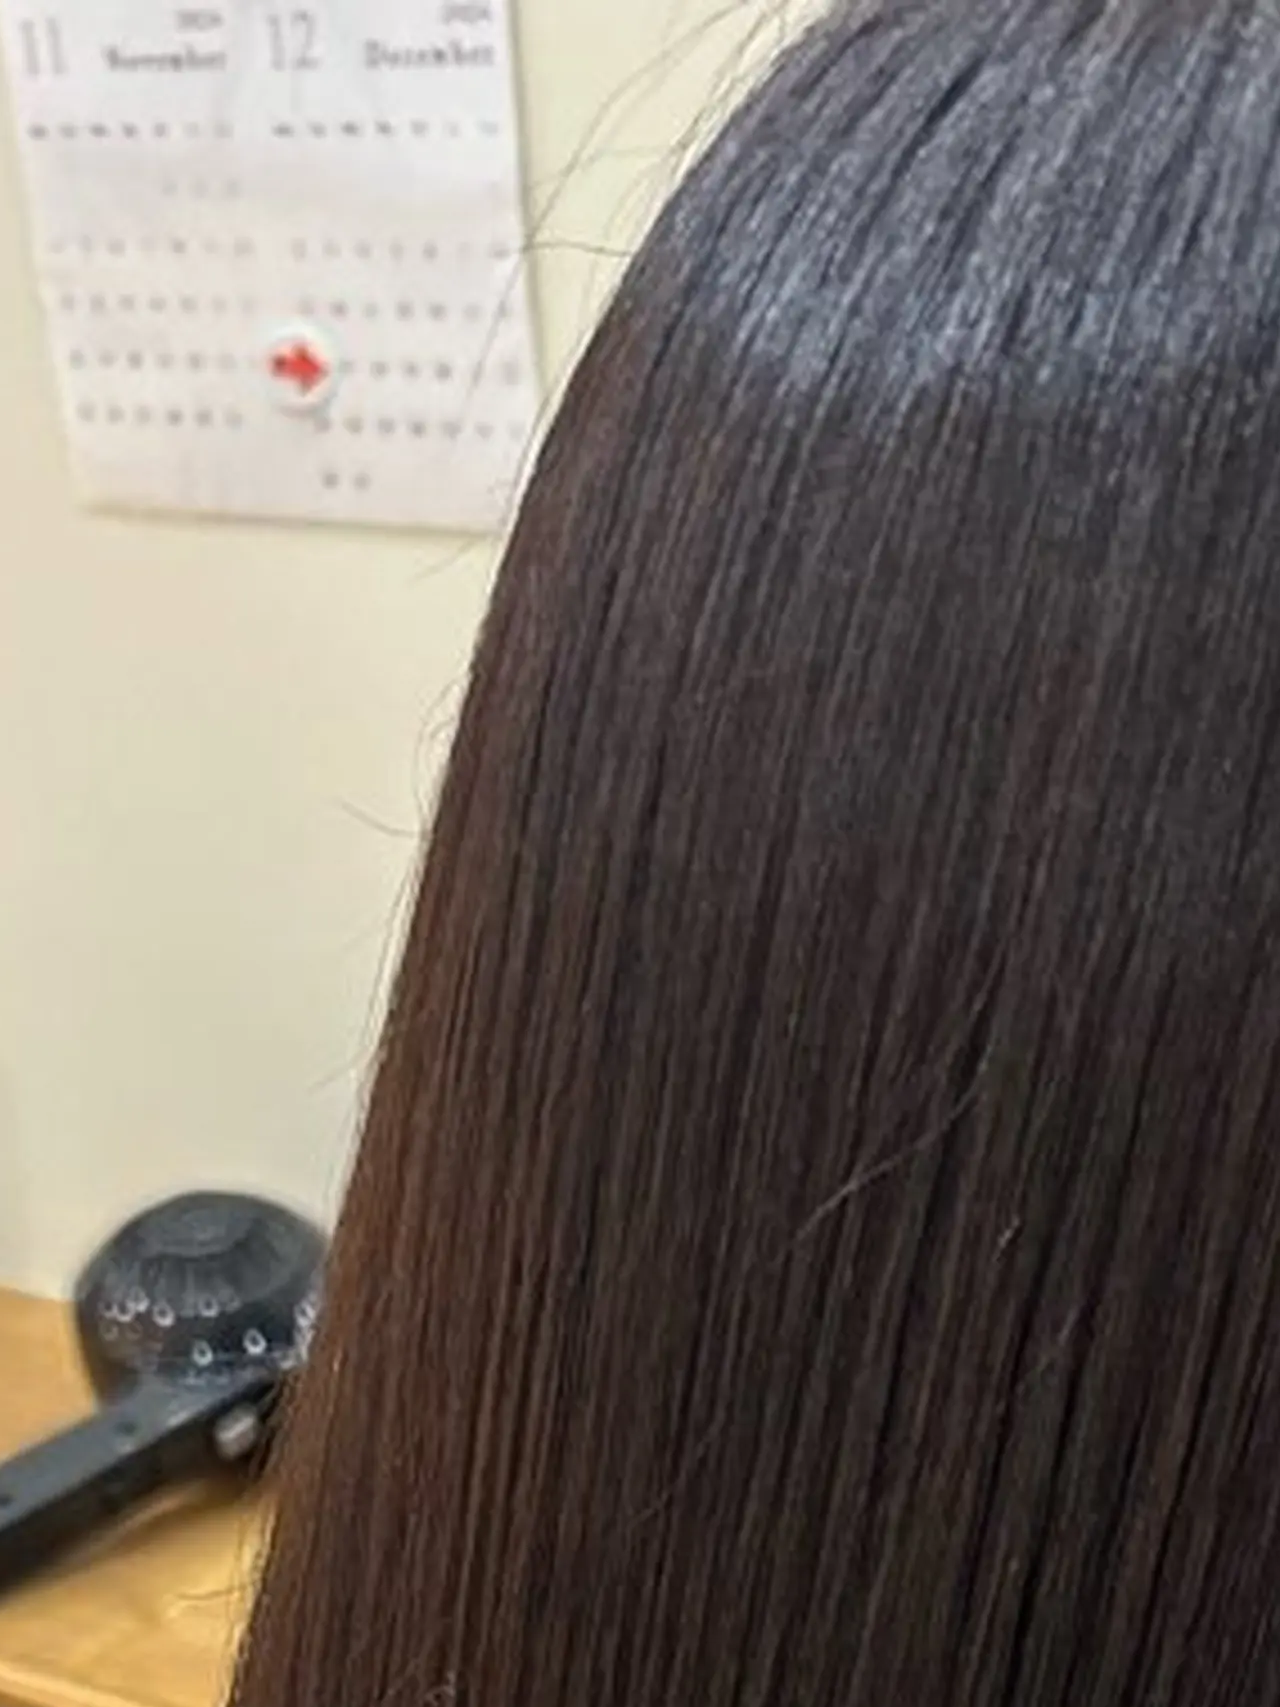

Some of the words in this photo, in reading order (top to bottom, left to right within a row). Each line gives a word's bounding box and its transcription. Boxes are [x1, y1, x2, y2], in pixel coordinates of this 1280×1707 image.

[20, 17, 66, 77] 11
[268, 12, 321, 71] 12
[365, 39, 495, 70] December
